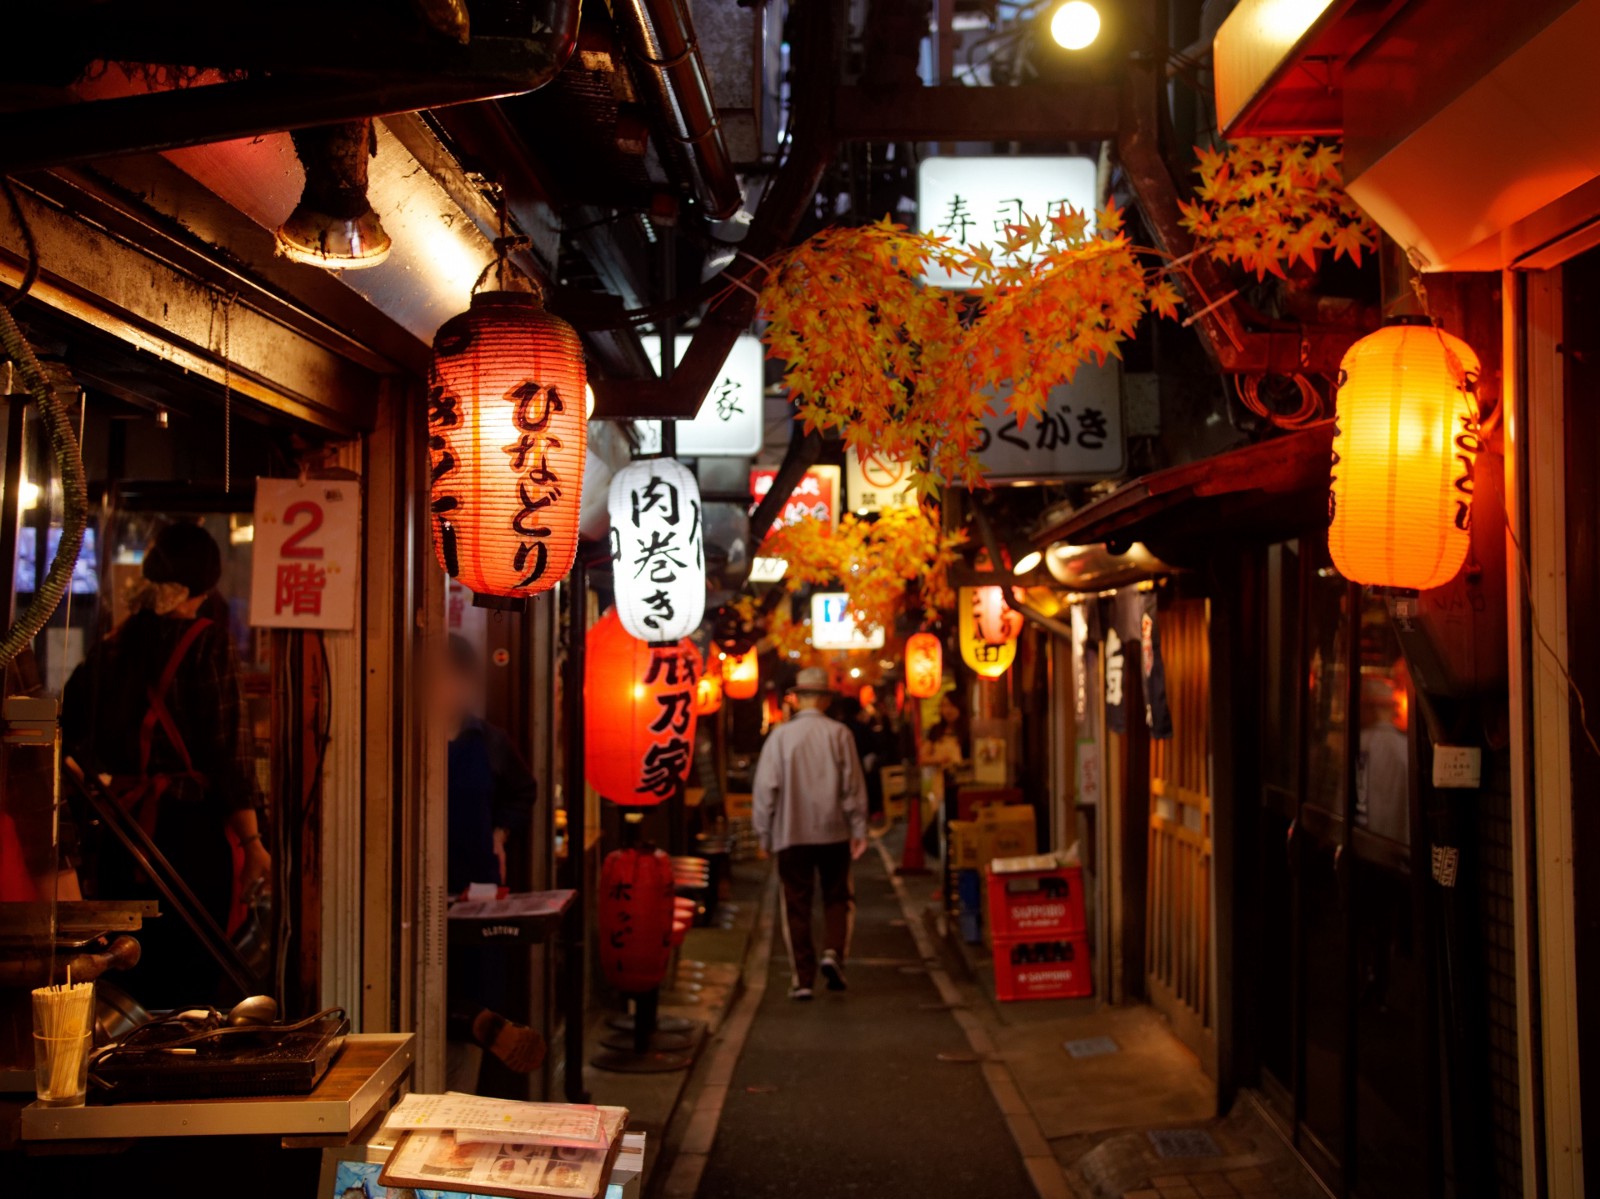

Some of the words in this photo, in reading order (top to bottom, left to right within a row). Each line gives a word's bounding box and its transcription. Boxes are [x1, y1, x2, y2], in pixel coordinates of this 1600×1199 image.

[275, 500, 327, 617] 2階
[502, 381, 564, 590] ひなどり
[631, 475, 688, 628] 肉巻き
